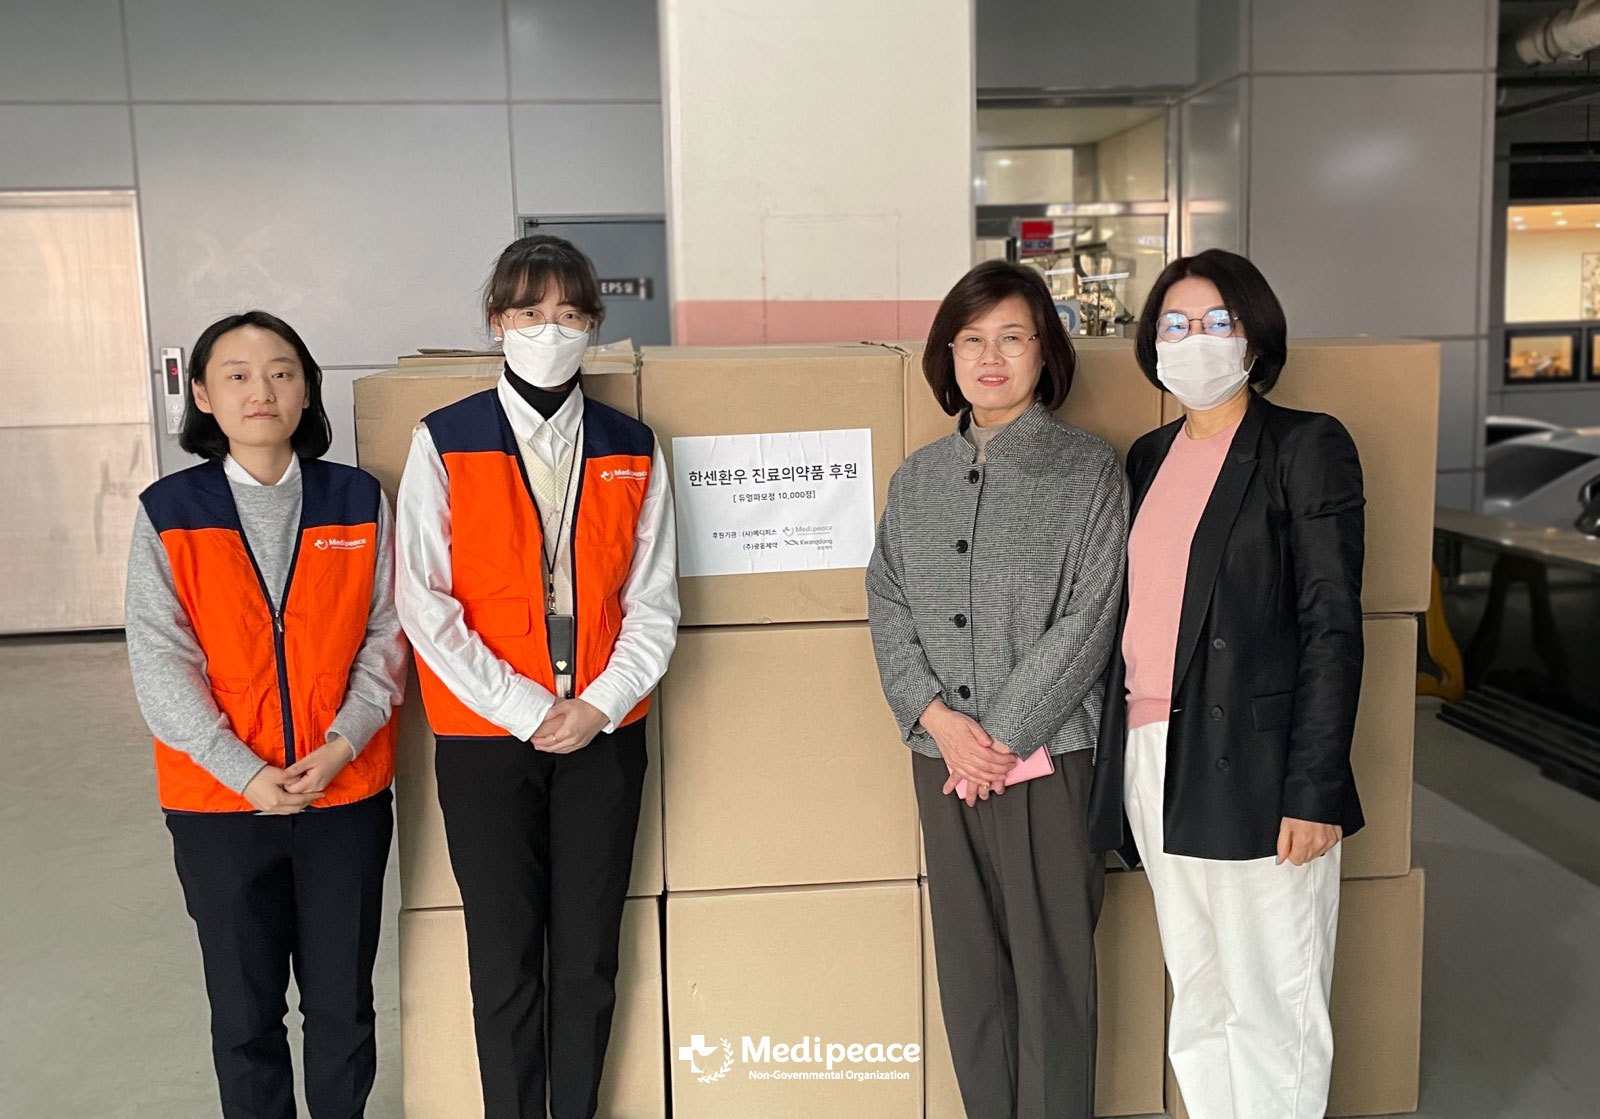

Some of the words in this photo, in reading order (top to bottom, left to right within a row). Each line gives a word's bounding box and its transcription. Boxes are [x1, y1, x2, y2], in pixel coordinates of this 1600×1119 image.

[688, 469, 748, 487] 한센환우
[751, 465, 825, 484] 진료의약품
[829, 462, 858, 480] 후원
[795, 525, 833, 535] Medipeace
